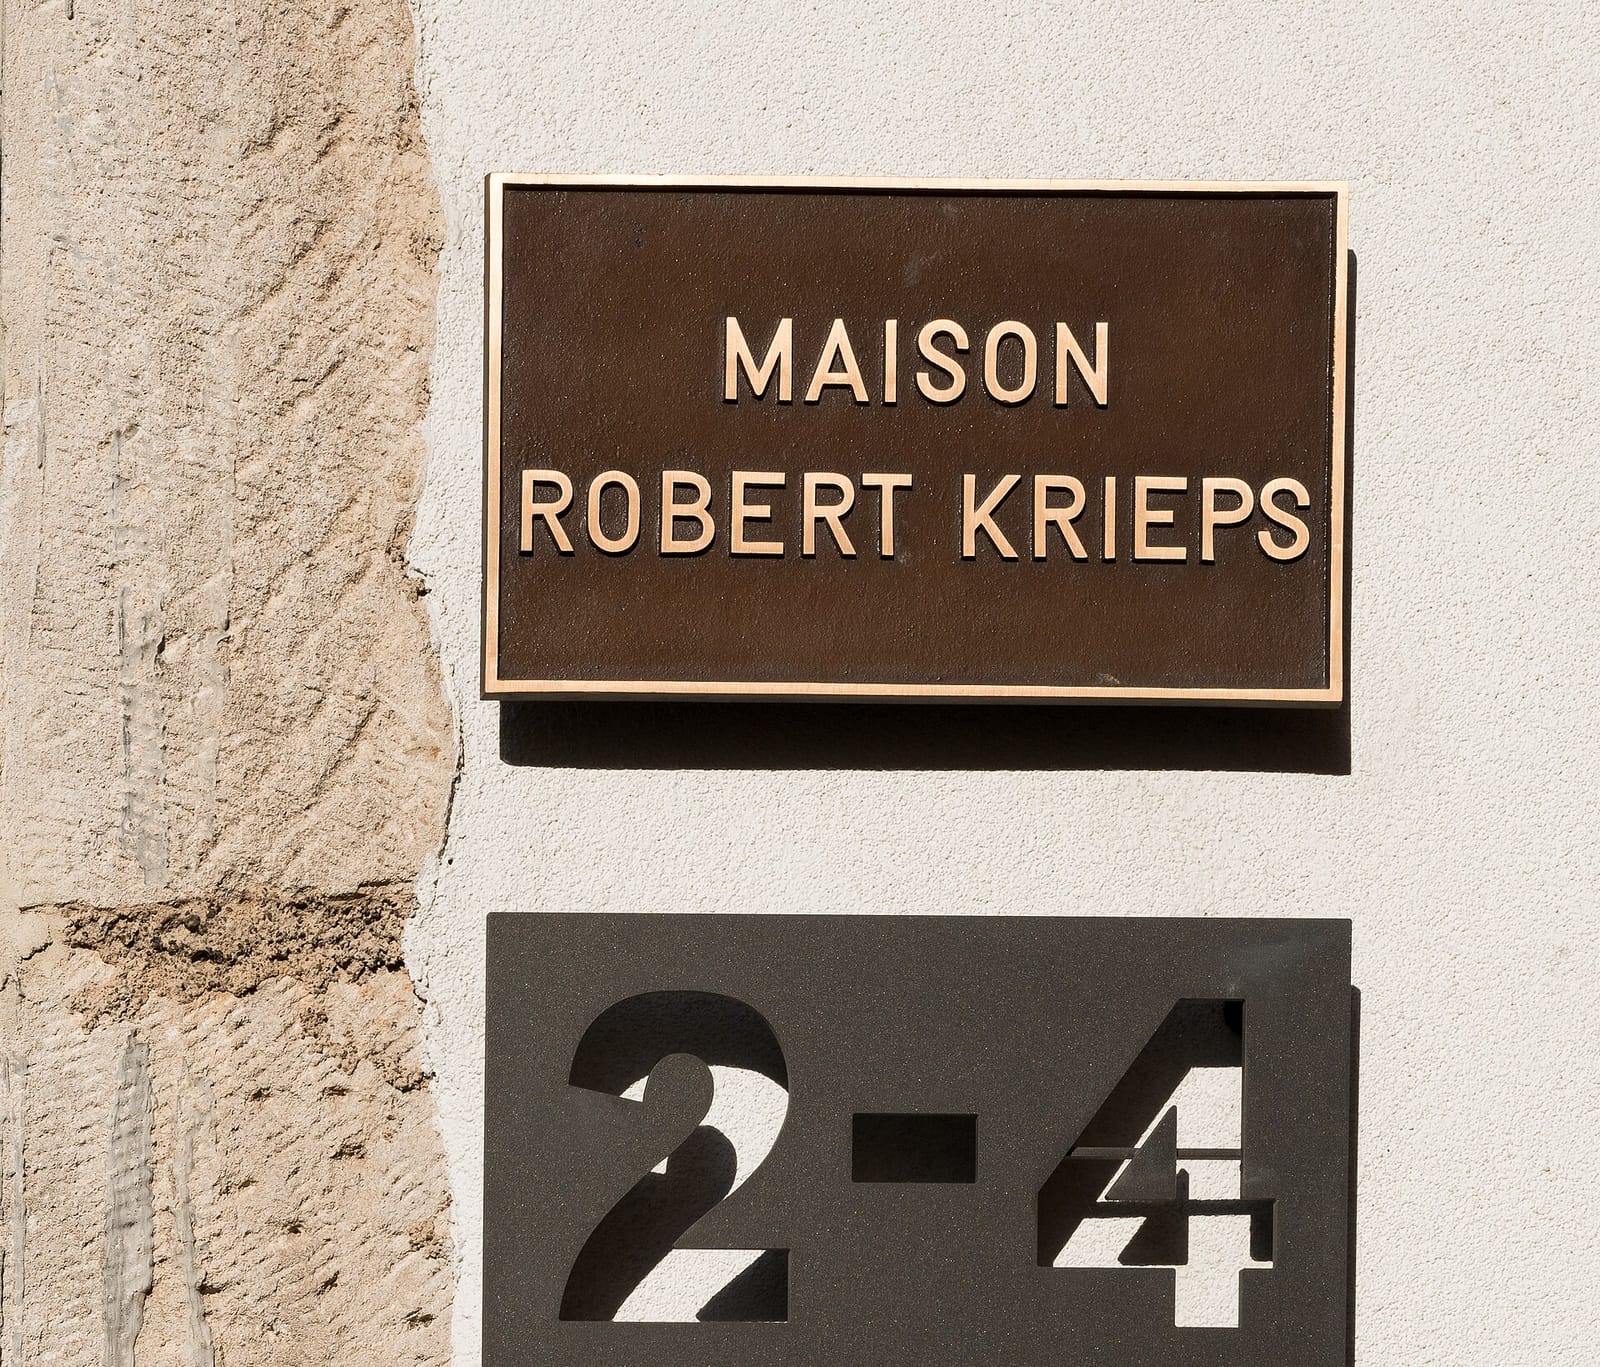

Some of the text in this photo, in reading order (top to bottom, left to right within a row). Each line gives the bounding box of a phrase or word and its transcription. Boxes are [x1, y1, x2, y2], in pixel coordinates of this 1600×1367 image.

[723, 317, 1109, 405] MAISON
[520, 469, 1311, 561] ROBERT KRIEPS
